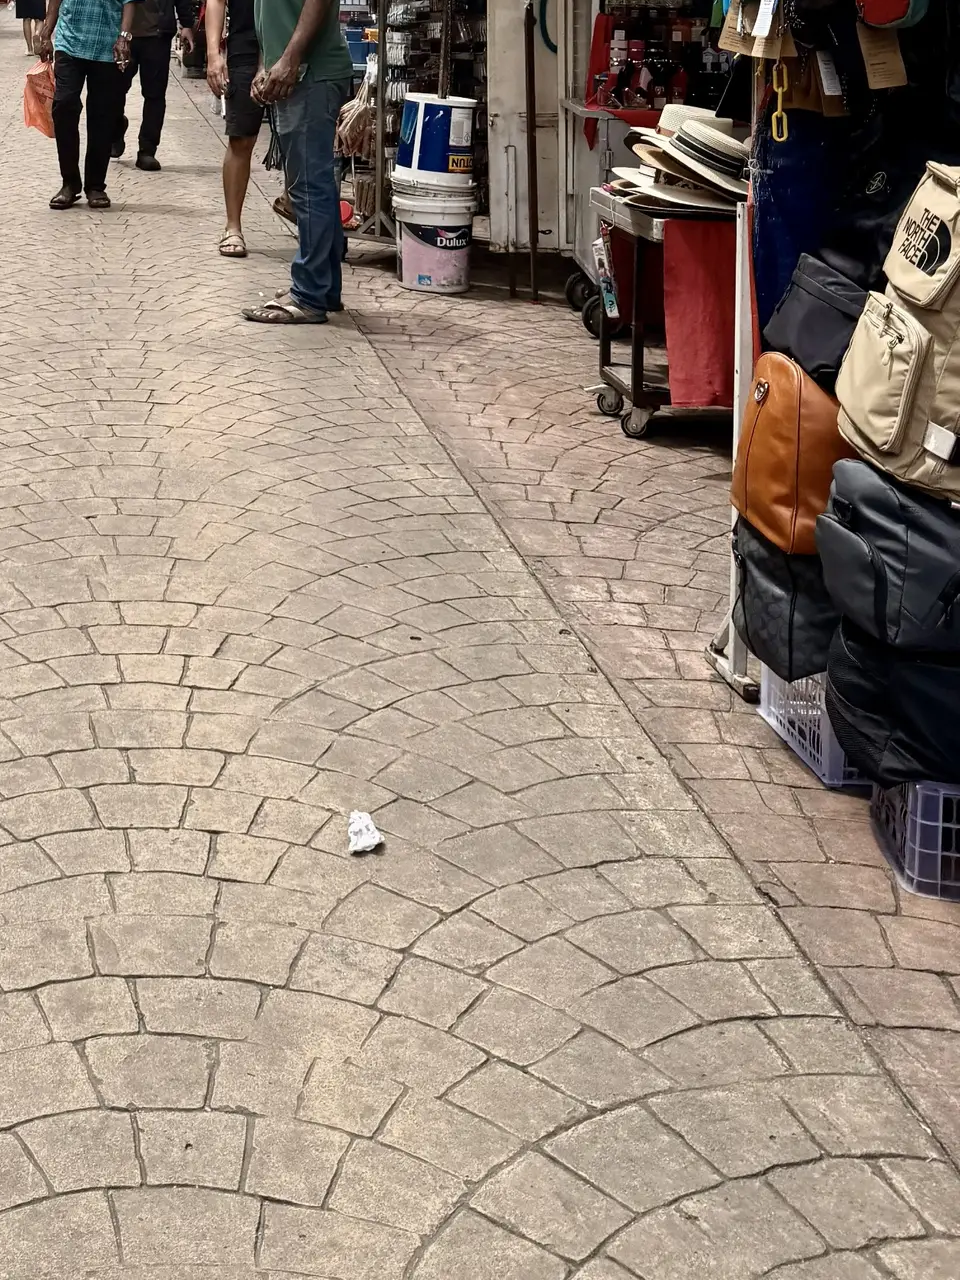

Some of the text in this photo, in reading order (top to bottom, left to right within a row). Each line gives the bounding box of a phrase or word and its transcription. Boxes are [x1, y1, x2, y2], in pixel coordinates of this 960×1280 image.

[902, 216, 932, 249] NORTH
[920, 207, 940, 232] THE
[436, 236, 467, 247] Dulux
[897, 237, 922, 266] FACE
